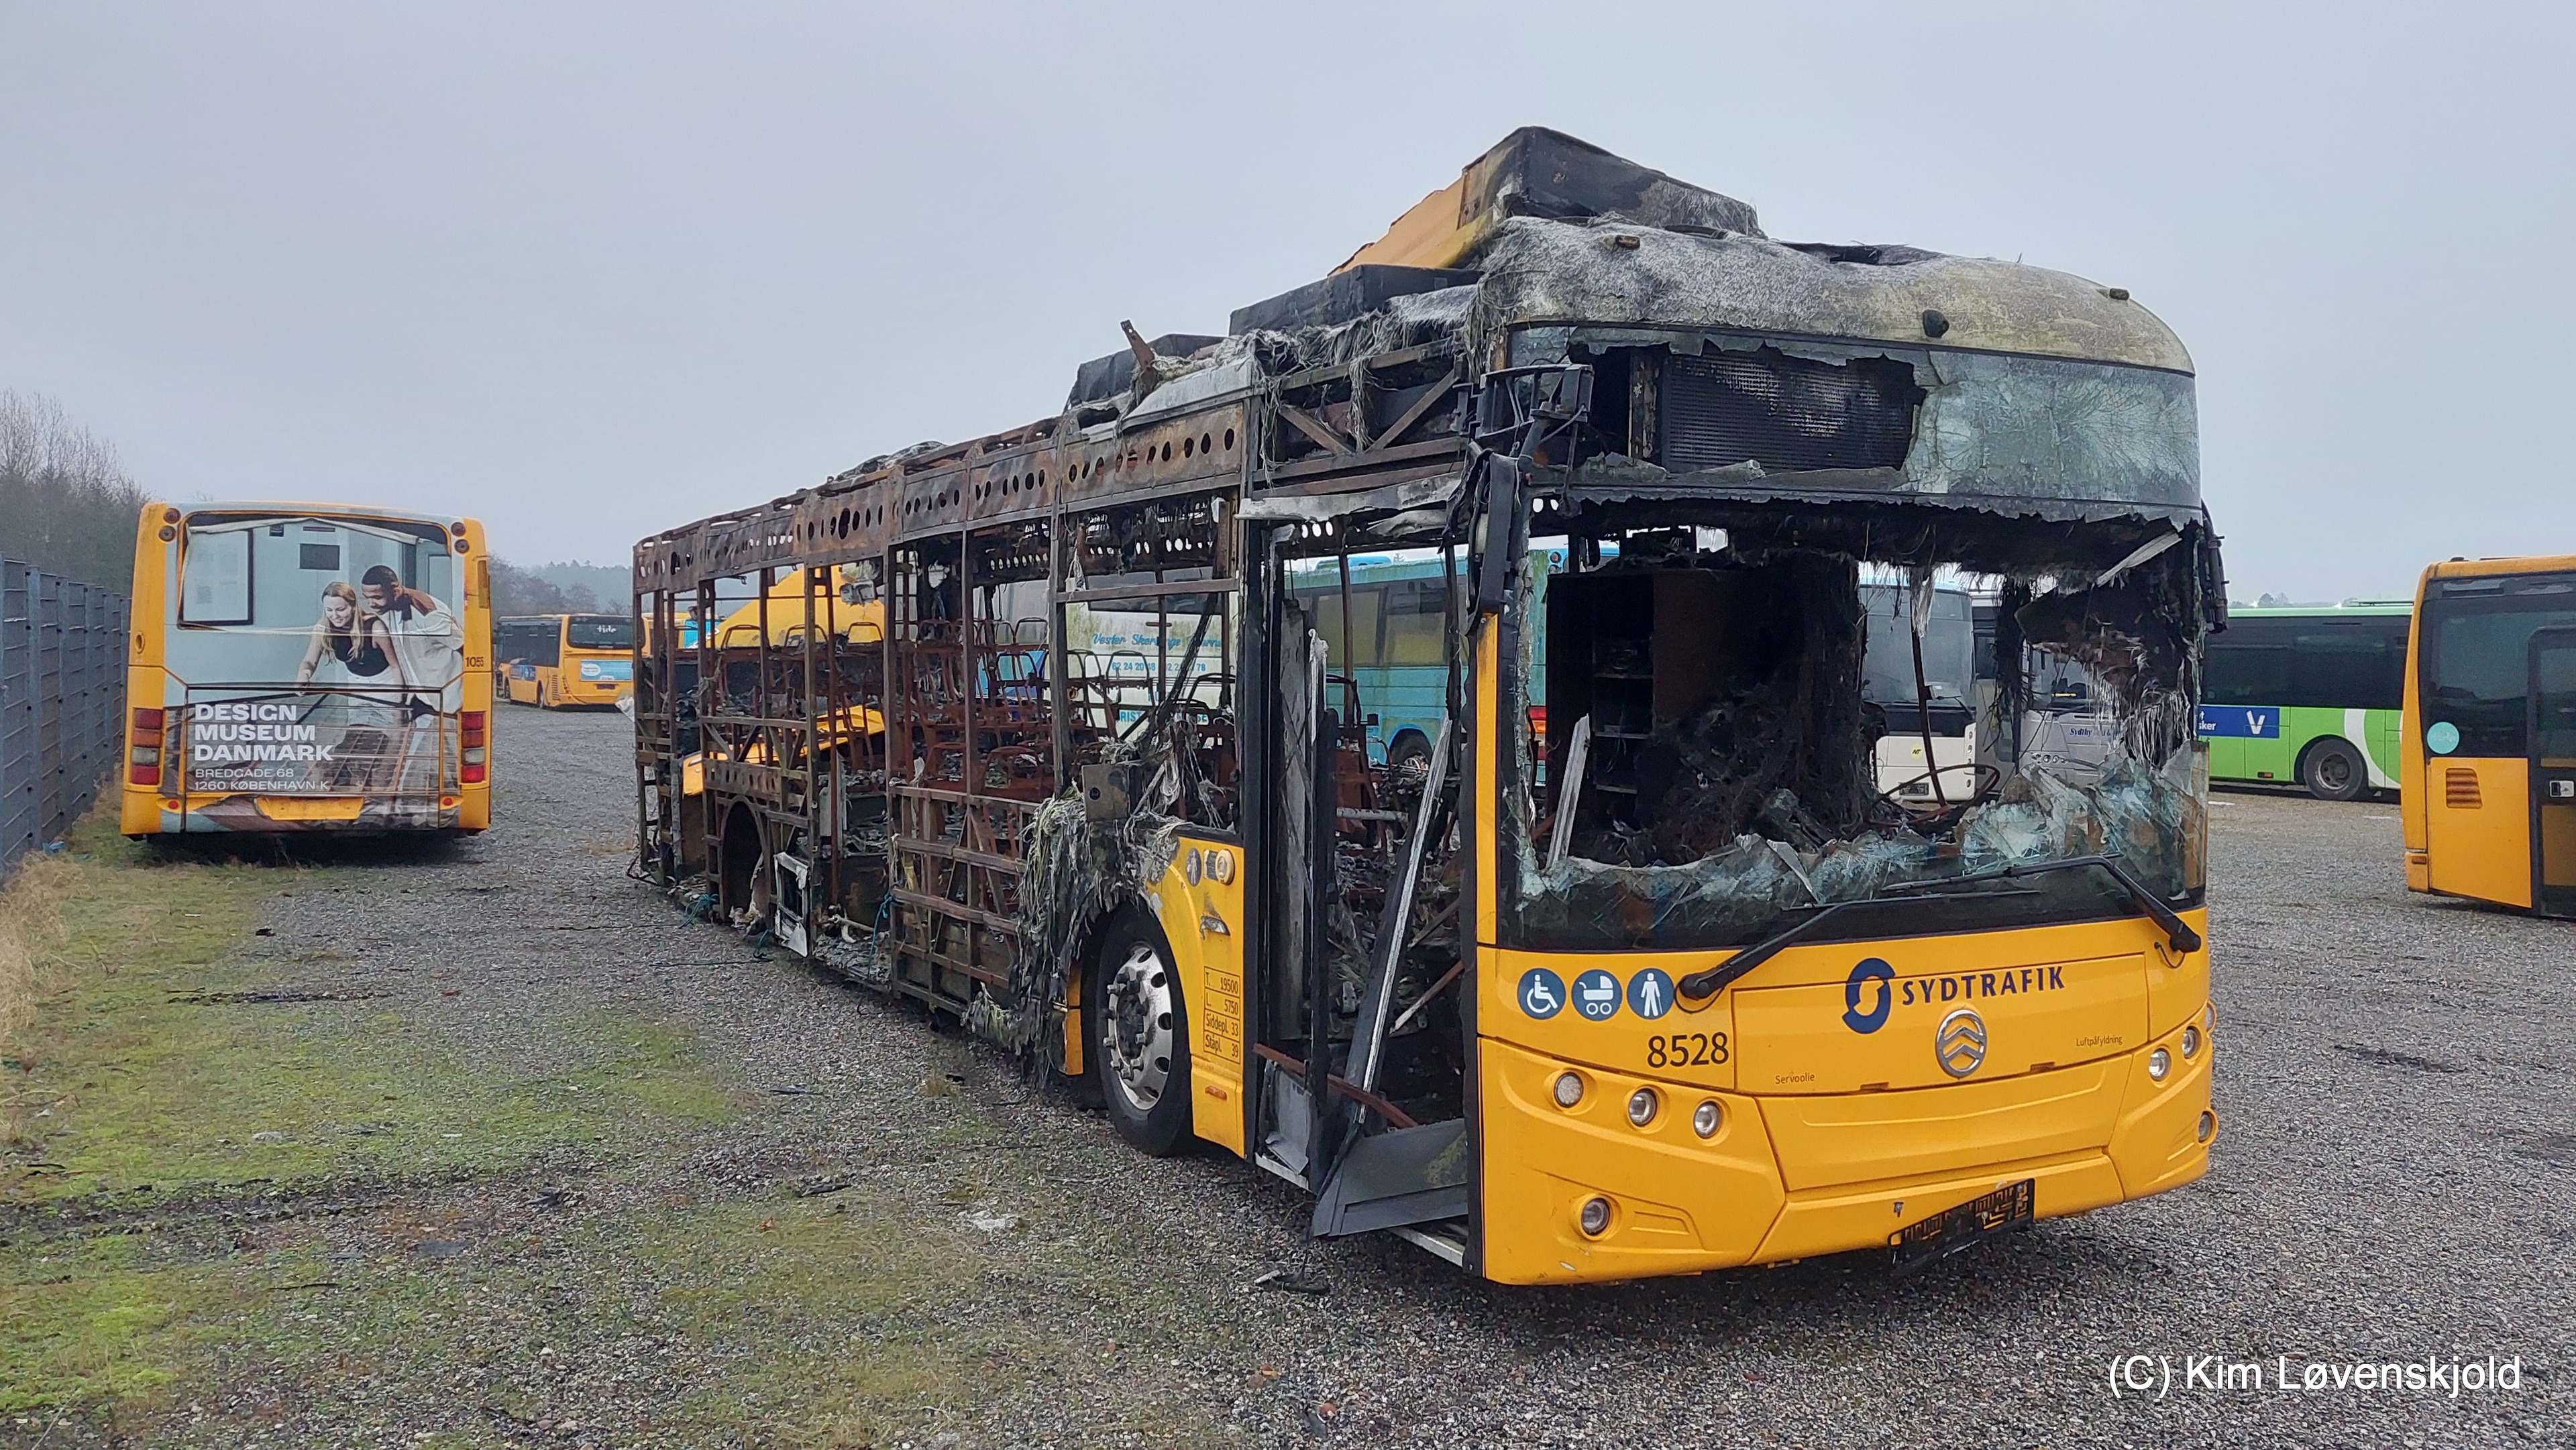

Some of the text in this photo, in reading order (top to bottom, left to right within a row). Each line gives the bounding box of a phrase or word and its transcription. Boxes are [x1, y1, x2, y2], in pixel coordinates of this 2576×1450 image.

[596, 625, 616, 633] tide
[1091, 633, 1127, 645] Vester
[1124, 662, 1133, 671] 24
[1135, 662, 1144, 671] 20
[195, 704, 297, 721] DESIGN
[195, 724, 315, 741] MUSEUM
[195, 744, 333, 761] DANMARK
[195, 769, 294, 778] BREDGADE 68
[195, 781, 329, 790] 1260 KØBENHAVN K
[1220, 977, 1238, 994] 19500
[1902, 966, 2065, 1006] SYDTRAFIK
[1224, 999, 1238, 1015] 5750
[1231, 1022, 1238, 1036] 33
[2076, 1034, 2123, 1047] Luftpåfyldning
[1232, 1044, 1238, 1058] 39
[1647, 1031, 1729, 1068] 8528
[1775, 1072, 1815, 1084] Servoolie
